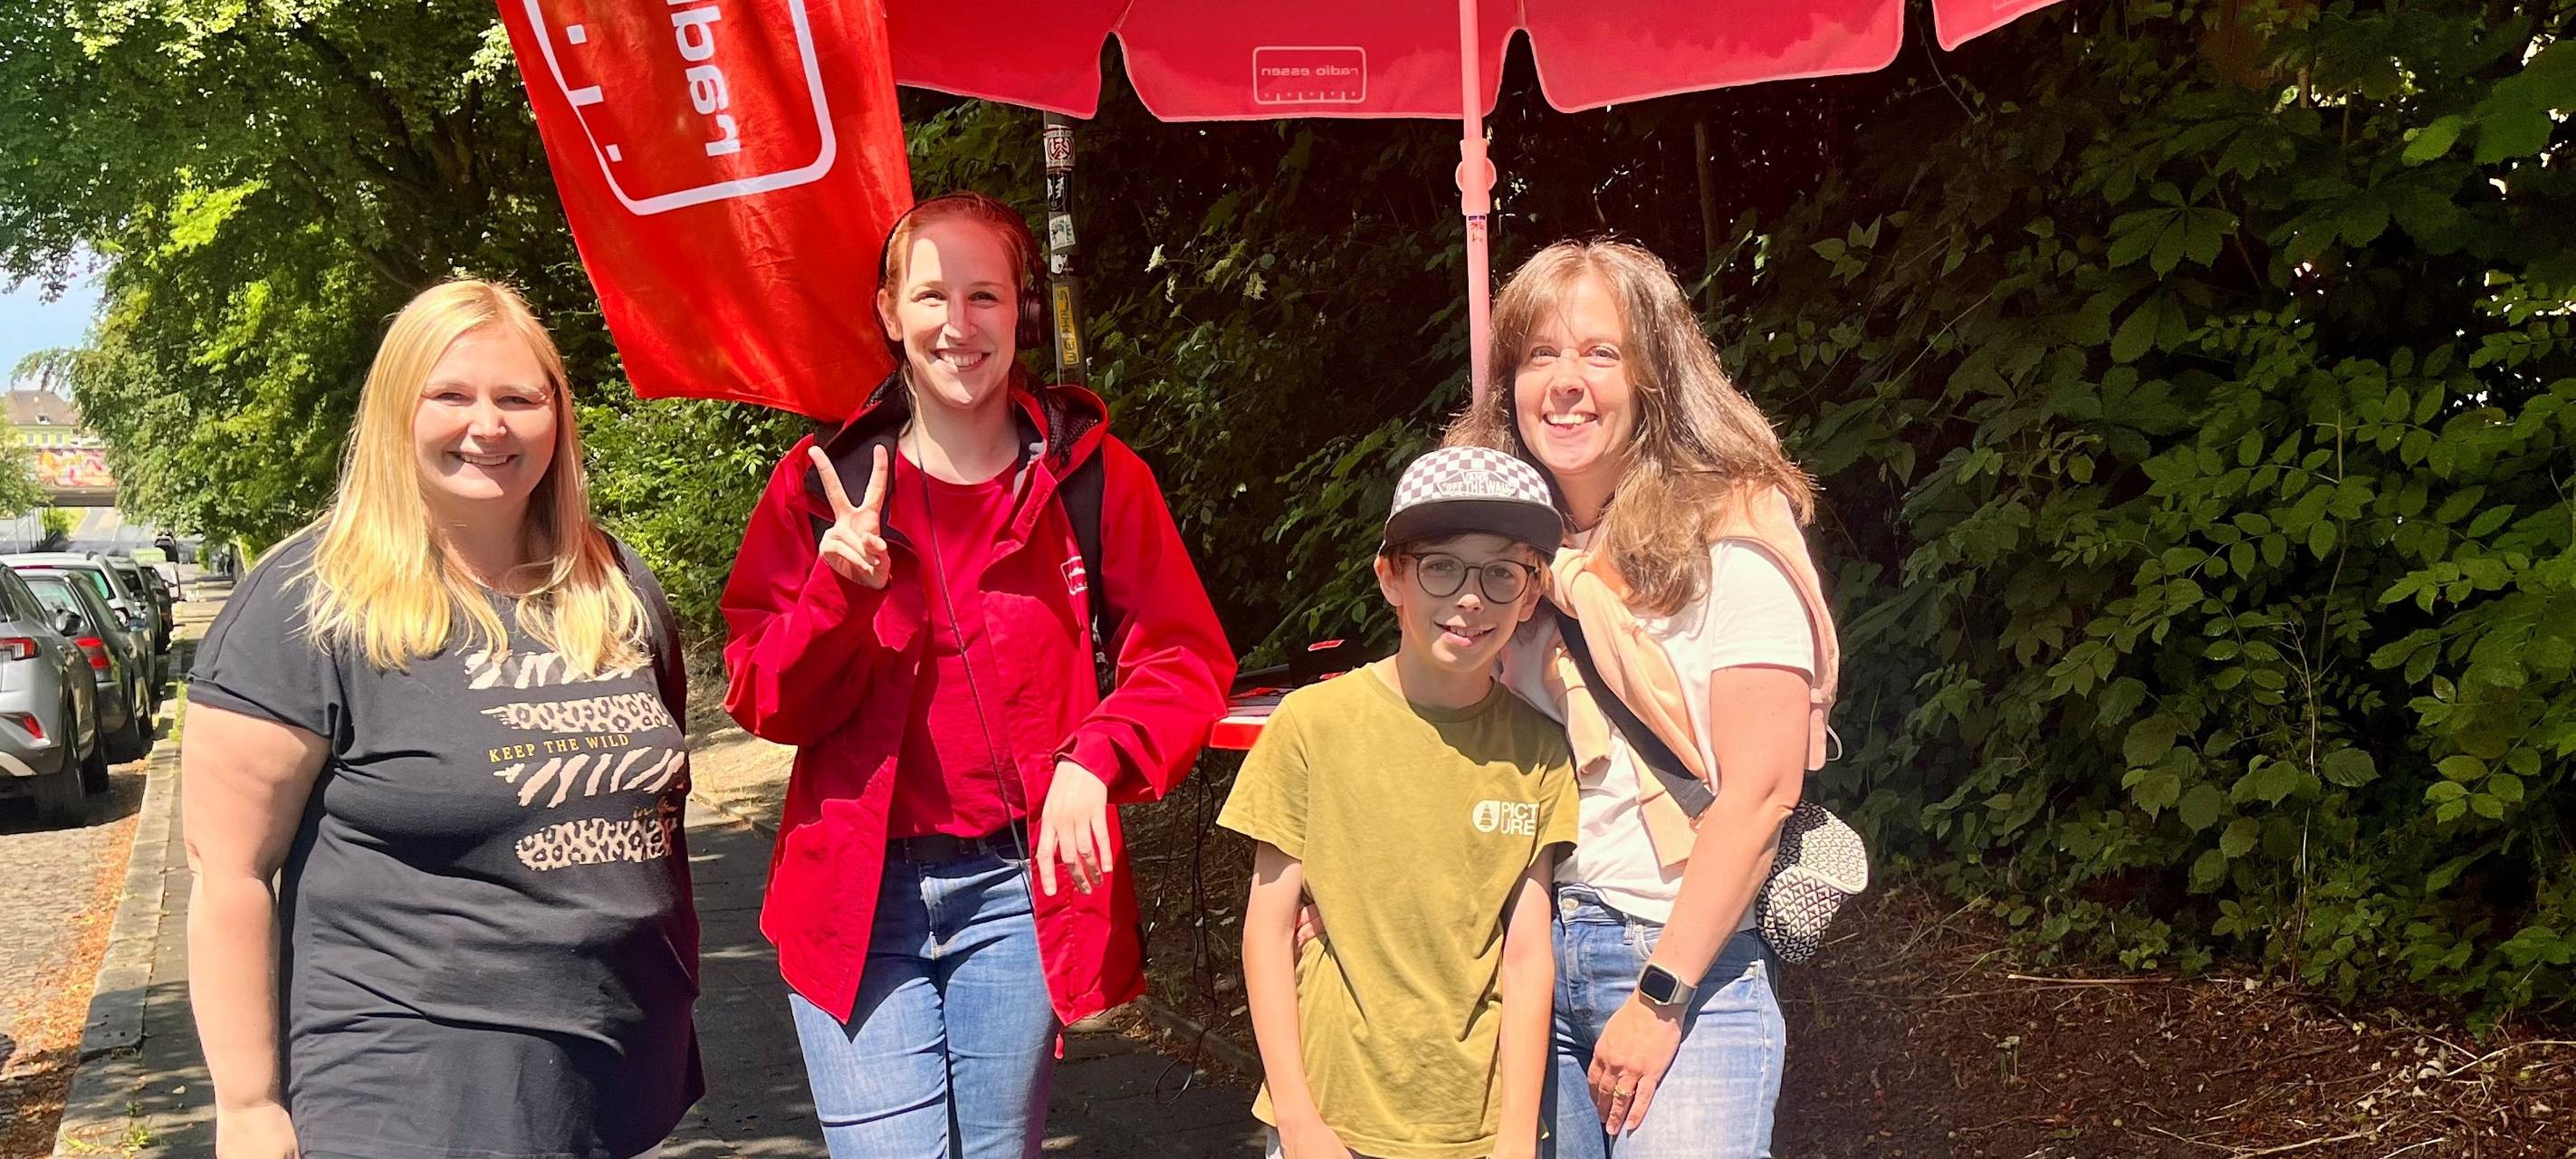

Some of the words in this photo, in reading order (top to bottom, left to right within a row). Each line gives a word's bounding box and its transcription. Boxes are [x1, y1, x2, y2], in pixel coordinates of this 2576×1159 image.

[488, 742, 535, 763] KEEP
[543, 739, 580, 753] THE
[586, 733, 630, 750] WILD
[1501, 802, 1539, 819] PICT
[1500, 819, 1536, 835] URE
